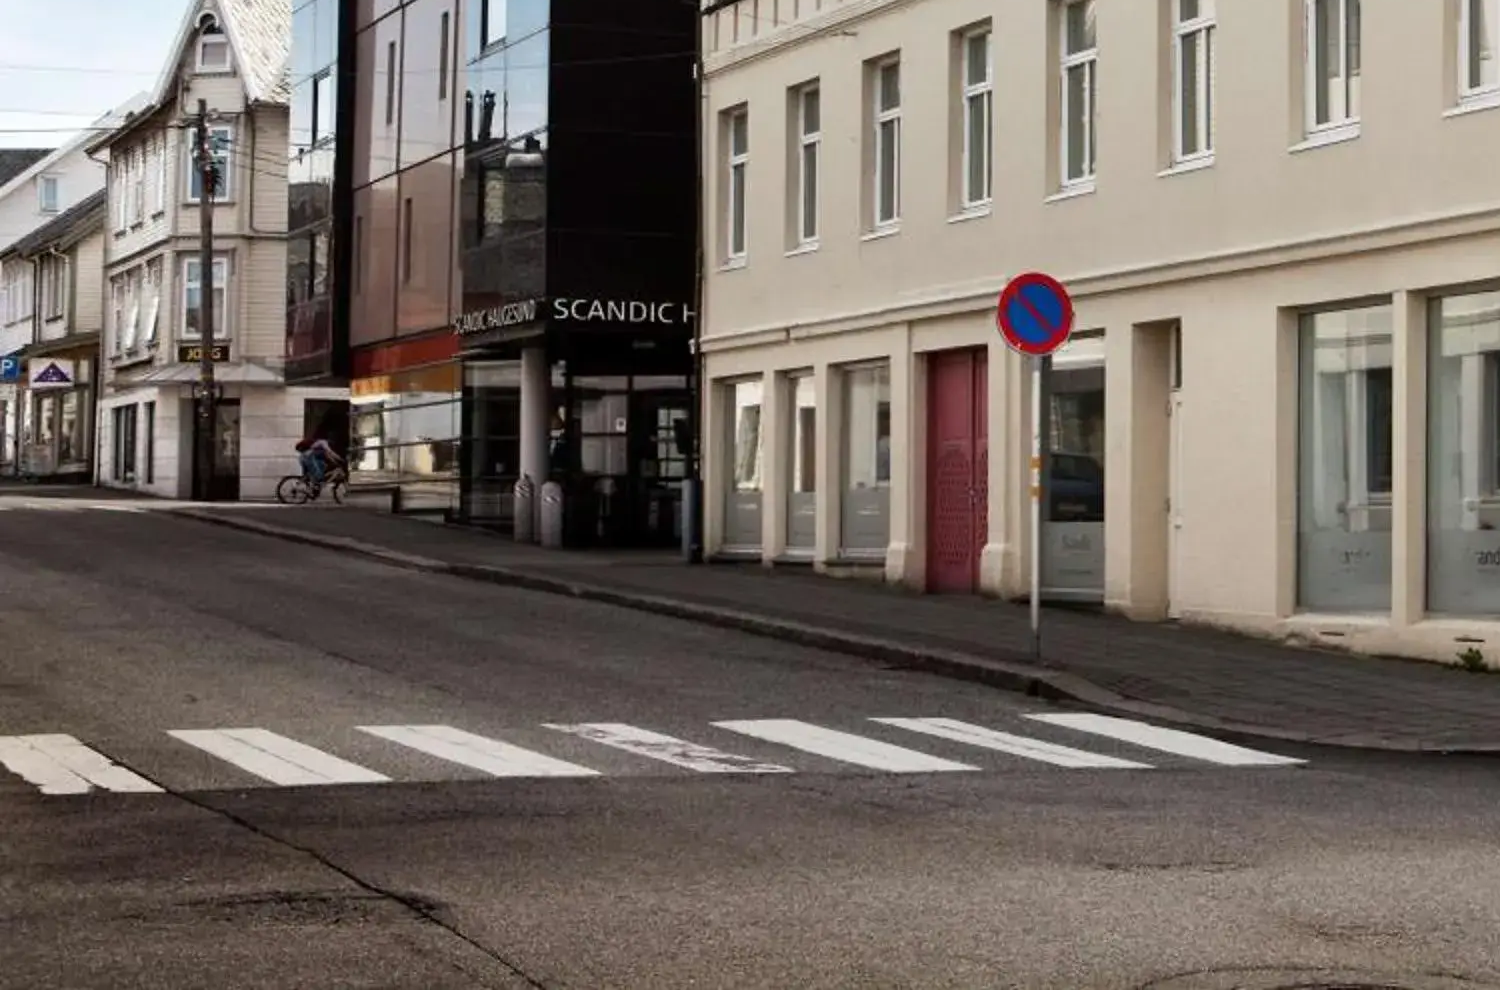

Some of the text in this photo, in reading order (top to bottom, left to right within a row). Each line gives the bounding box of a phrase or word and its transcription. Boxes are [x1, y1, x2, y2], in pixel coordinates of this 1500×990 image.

[553, 298, 698, 323] SCANDIC H
[2, 359, 13, 375] P
